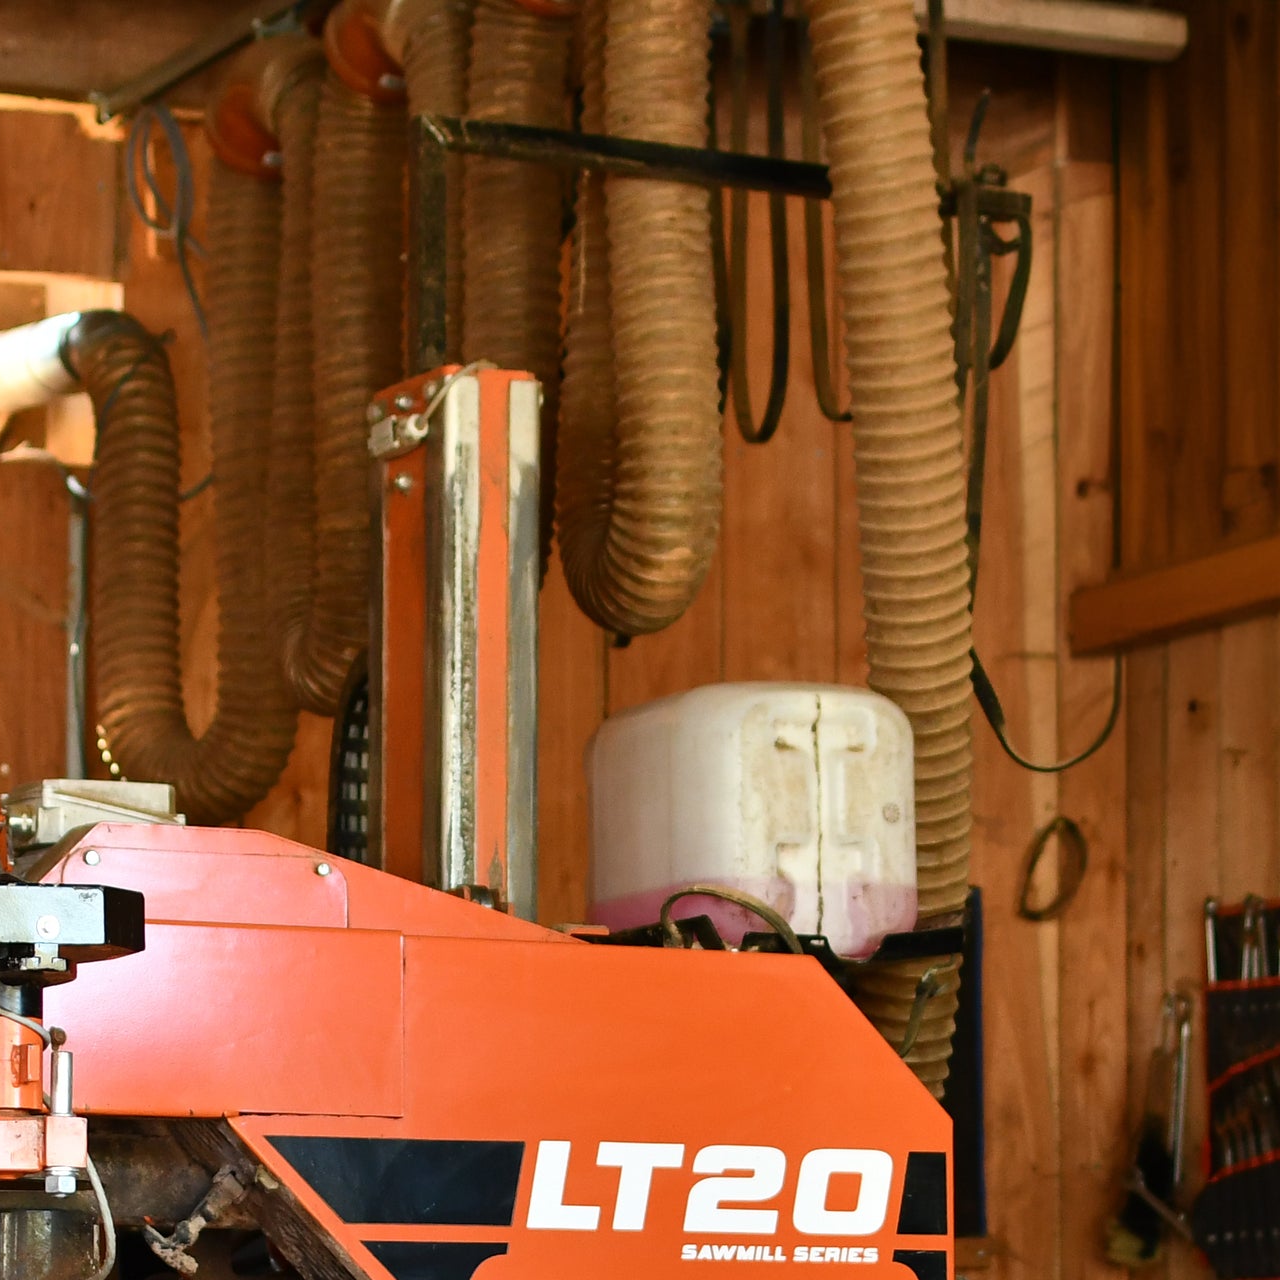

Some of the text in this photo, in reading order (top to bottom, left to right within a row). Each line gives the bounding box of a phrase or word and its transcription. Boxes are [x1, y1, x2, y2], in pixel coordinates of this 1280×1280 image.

[526, 1140, 894, 1235] LT20
[680, 1243, 879, 1264] SAWMILL SERIES
